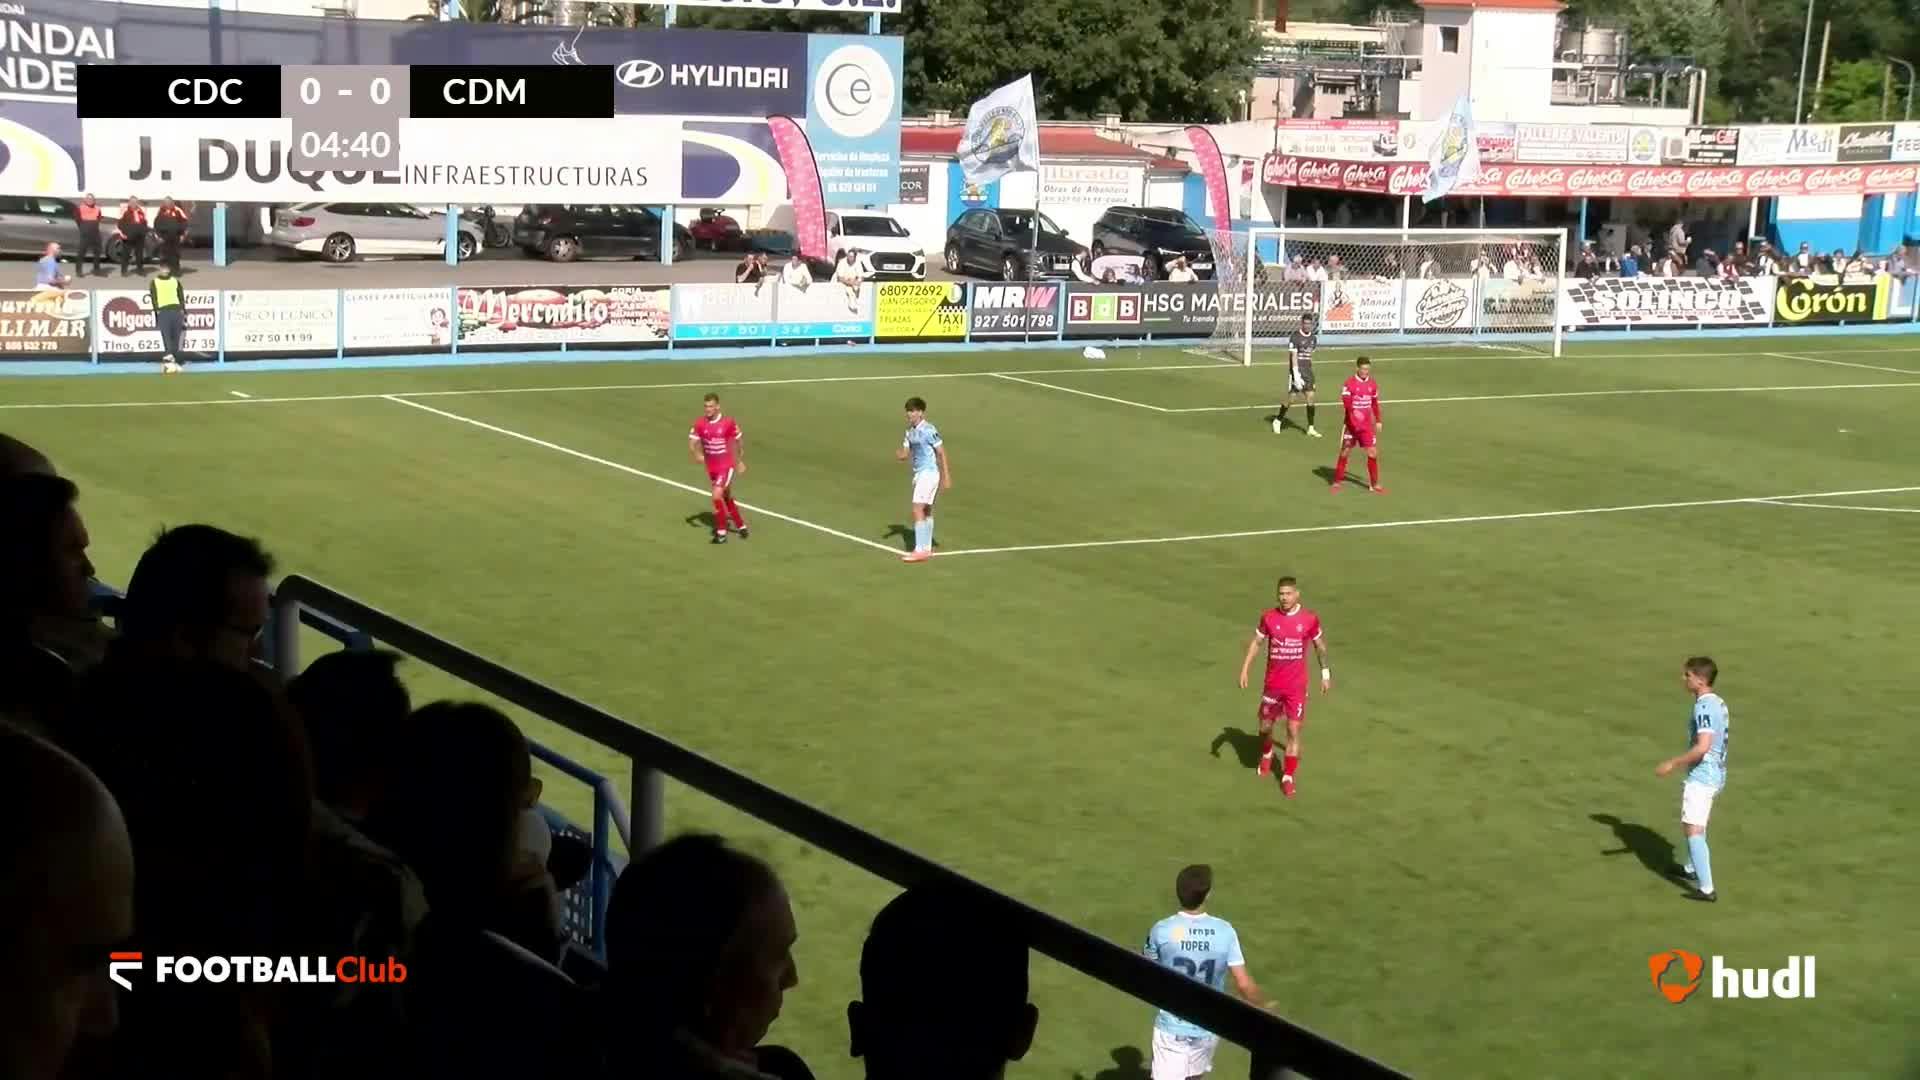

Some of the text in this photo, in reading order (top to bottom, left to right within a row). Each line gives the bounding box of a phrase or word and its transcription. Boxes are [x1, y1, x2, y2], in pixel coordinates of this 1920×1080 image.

[670, 64, 789, 89] HYUNDAI
[129, 136, 172, 181] J.
[404, 164, 648, 187] INFRAESTRUCTURAS
[879, 285, 943, 296] 680972692
[974, 286, 1057, 308] MRW
[1592, 289, 1743, 311] SOLINCO
[1777, 275, 1867, 321] Corón
[462, 288, 608, 325] Mercadito
[1144, 292, 1313, 312] HSG MATERIALES
[1360, 297, 1396, 307] Manuel
[109, 311, 157, 332] Miguel
[937, 313, 964, 325] TAXI
[974, 315, 1054, 328] 927 501 798
[1358, 311, 1396, 321] Valiente
[138, 339, 160, 350] 625
[201, 339, 215, 349] 39
[1180, 940, 1210, 952] TOPER
